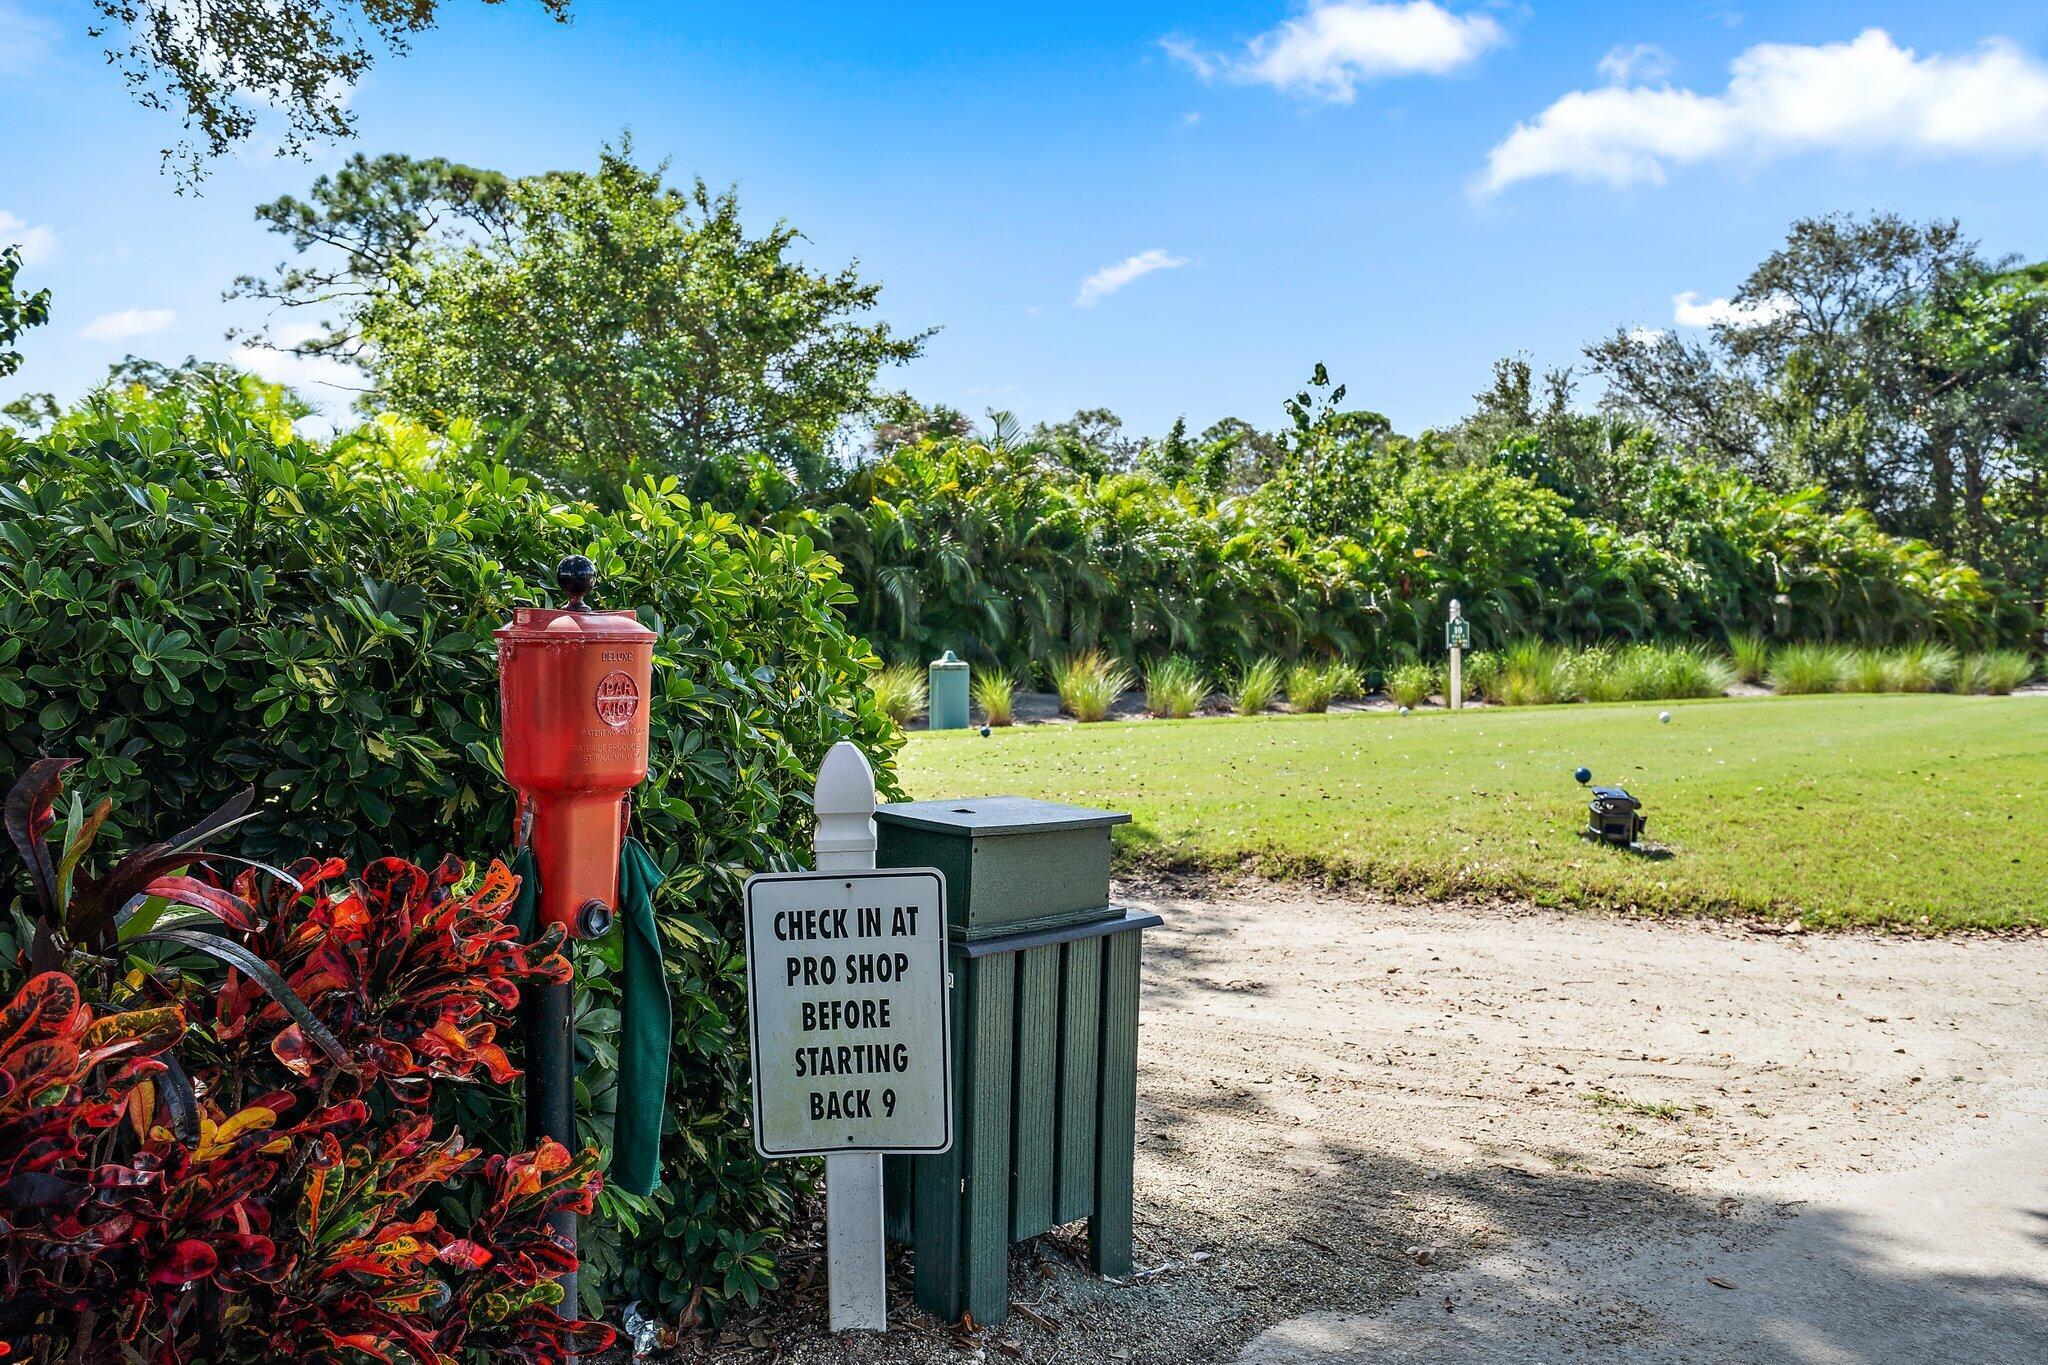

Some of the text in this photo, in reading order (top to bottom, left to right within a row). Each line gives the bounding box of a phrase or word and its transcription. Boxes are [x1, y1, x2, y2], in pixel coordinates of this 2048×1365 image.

[601, 651, 633, 662] DELUXE
[604, 682, 632, 696] PAR
[602, 702, 634, 717] AIDE
[773, 906, 919, 941] CHECK IN AT
[786, 953, 909, 987] PRO SHOP
[801, 999, 891, 1031] BEFORE
[795, 1043, 909, 1077] STARTING
[810, 1088, 897, 1121] BACK 9
